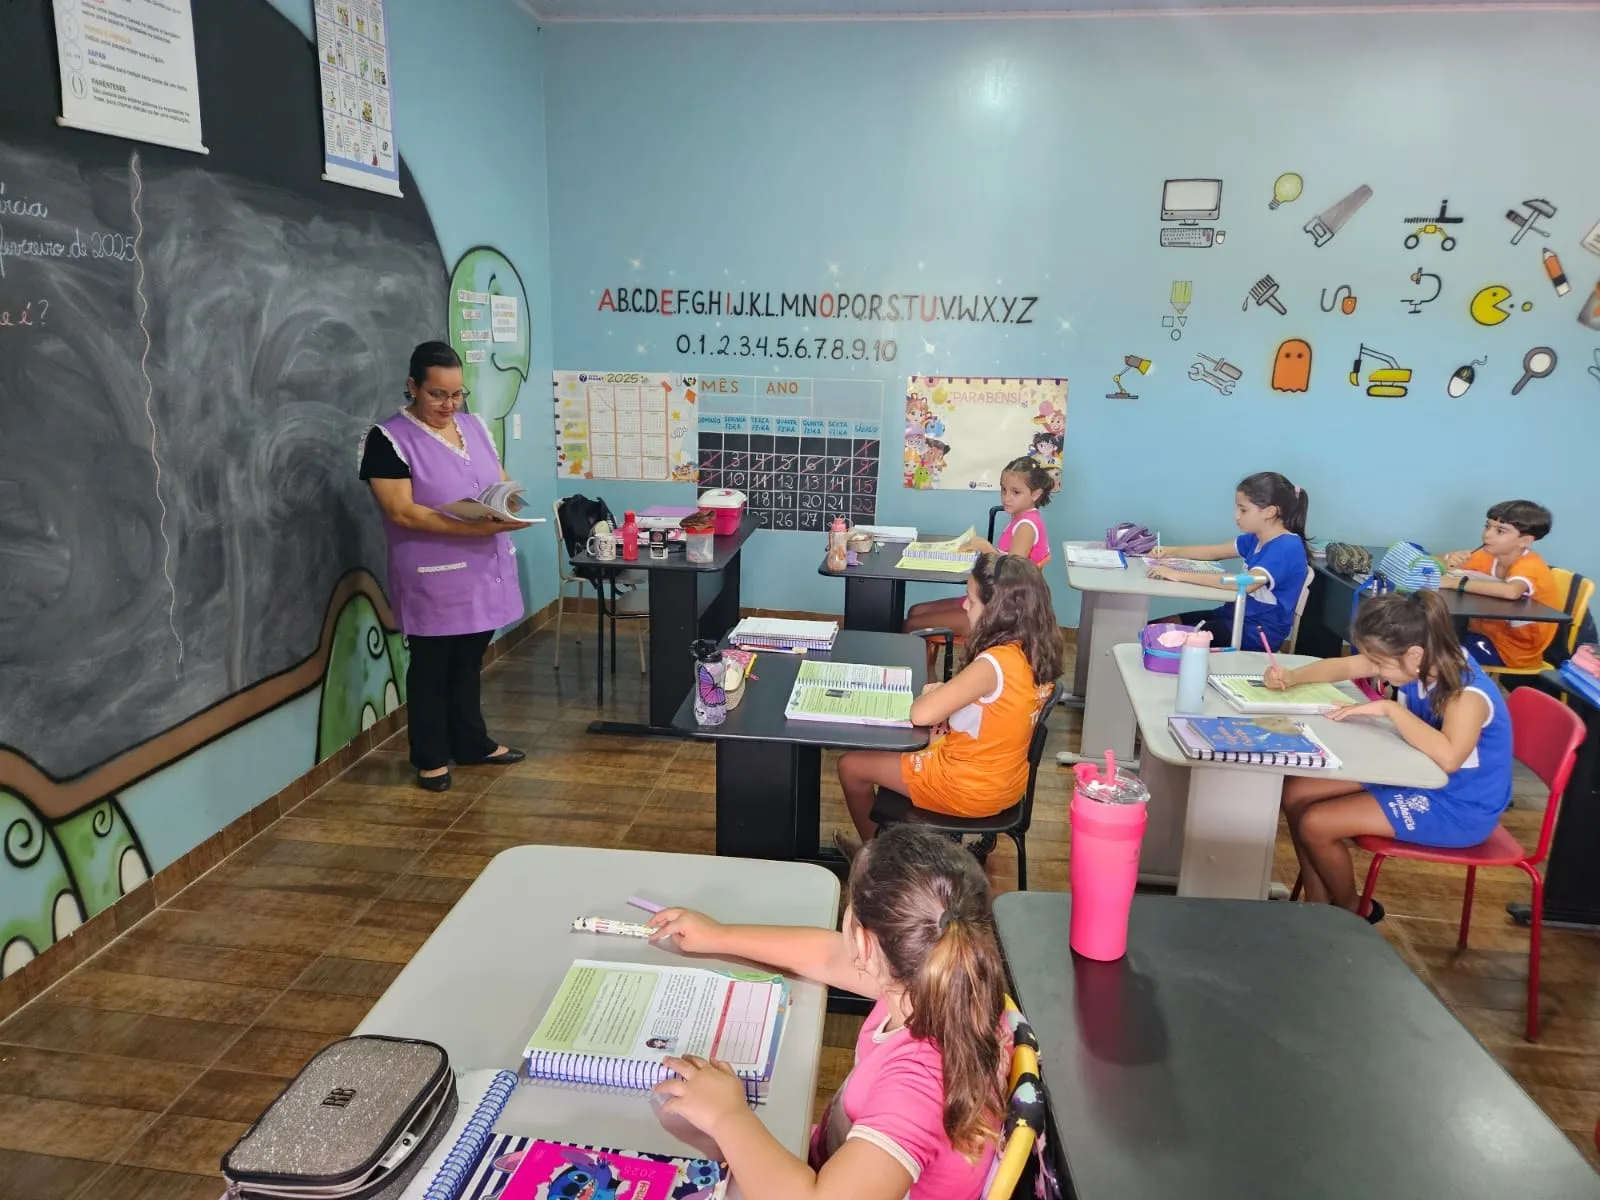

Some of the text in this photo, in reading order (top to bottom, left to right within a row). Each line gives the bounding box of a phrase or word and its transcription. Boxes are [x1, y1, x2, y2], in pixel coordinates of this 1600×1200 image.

[68, 228, 87, 259] de
[91, 231, 136, 261] 2025
[607, 373, 639, 384] 2025
[701, 378, 799, 394] MÊS ANO
[727, 472, 745, 486] 10
[778, 474, 794, 489] 12
[804, 475, 820, 491] 13
[829, 476, 845, 492] 14
[855, 478, 874, 493] 15
[752, 491, 874, 513] 18 19 20 21 22
[776, 512, 793, 527] 26
[801, 512, 818, 527] 27
